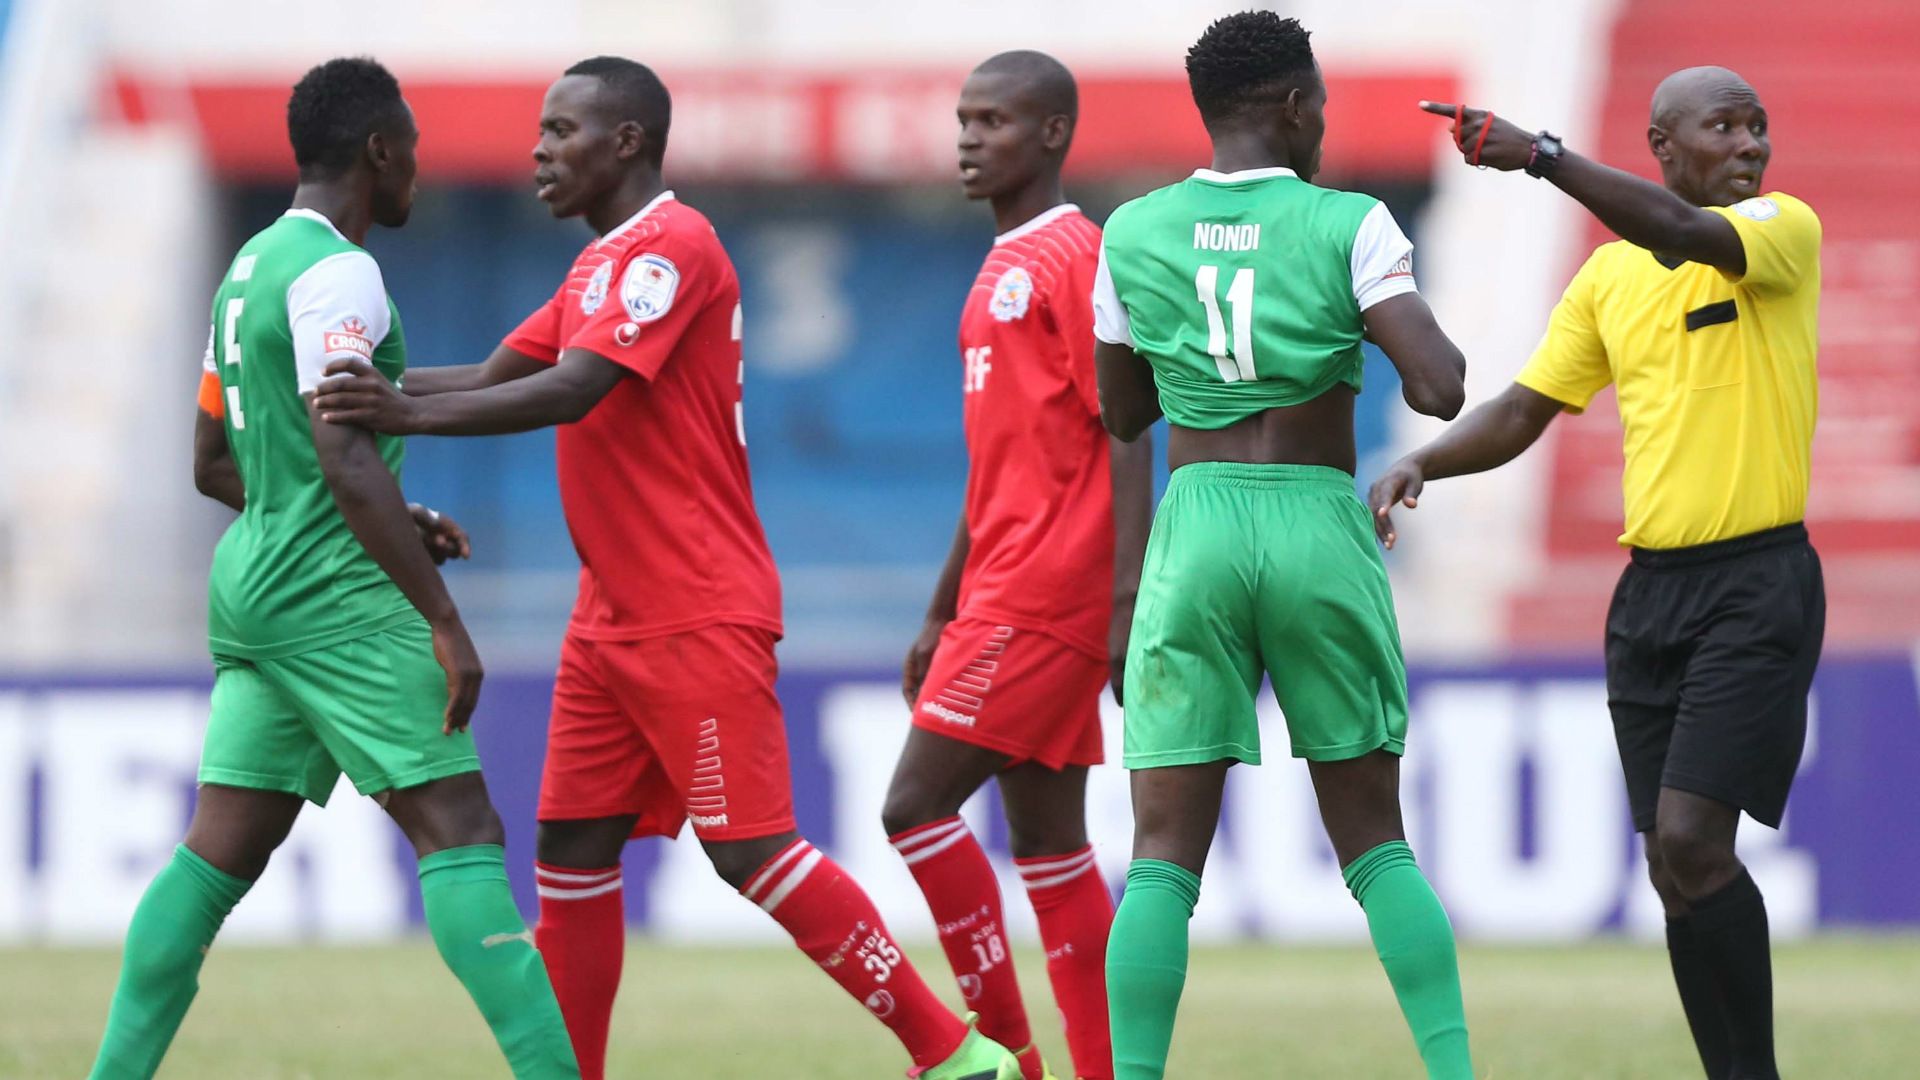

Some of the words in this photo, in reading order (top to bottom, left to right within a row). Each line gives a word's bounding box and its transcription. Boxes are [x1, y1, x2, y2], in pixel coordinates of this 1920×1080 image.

[1193, 222, 1260, 251] NONDI
[1195, 264, 1258, 383] 11
[864, 936, 901, 983] 35
[972, 934, 1006, 973] 18
